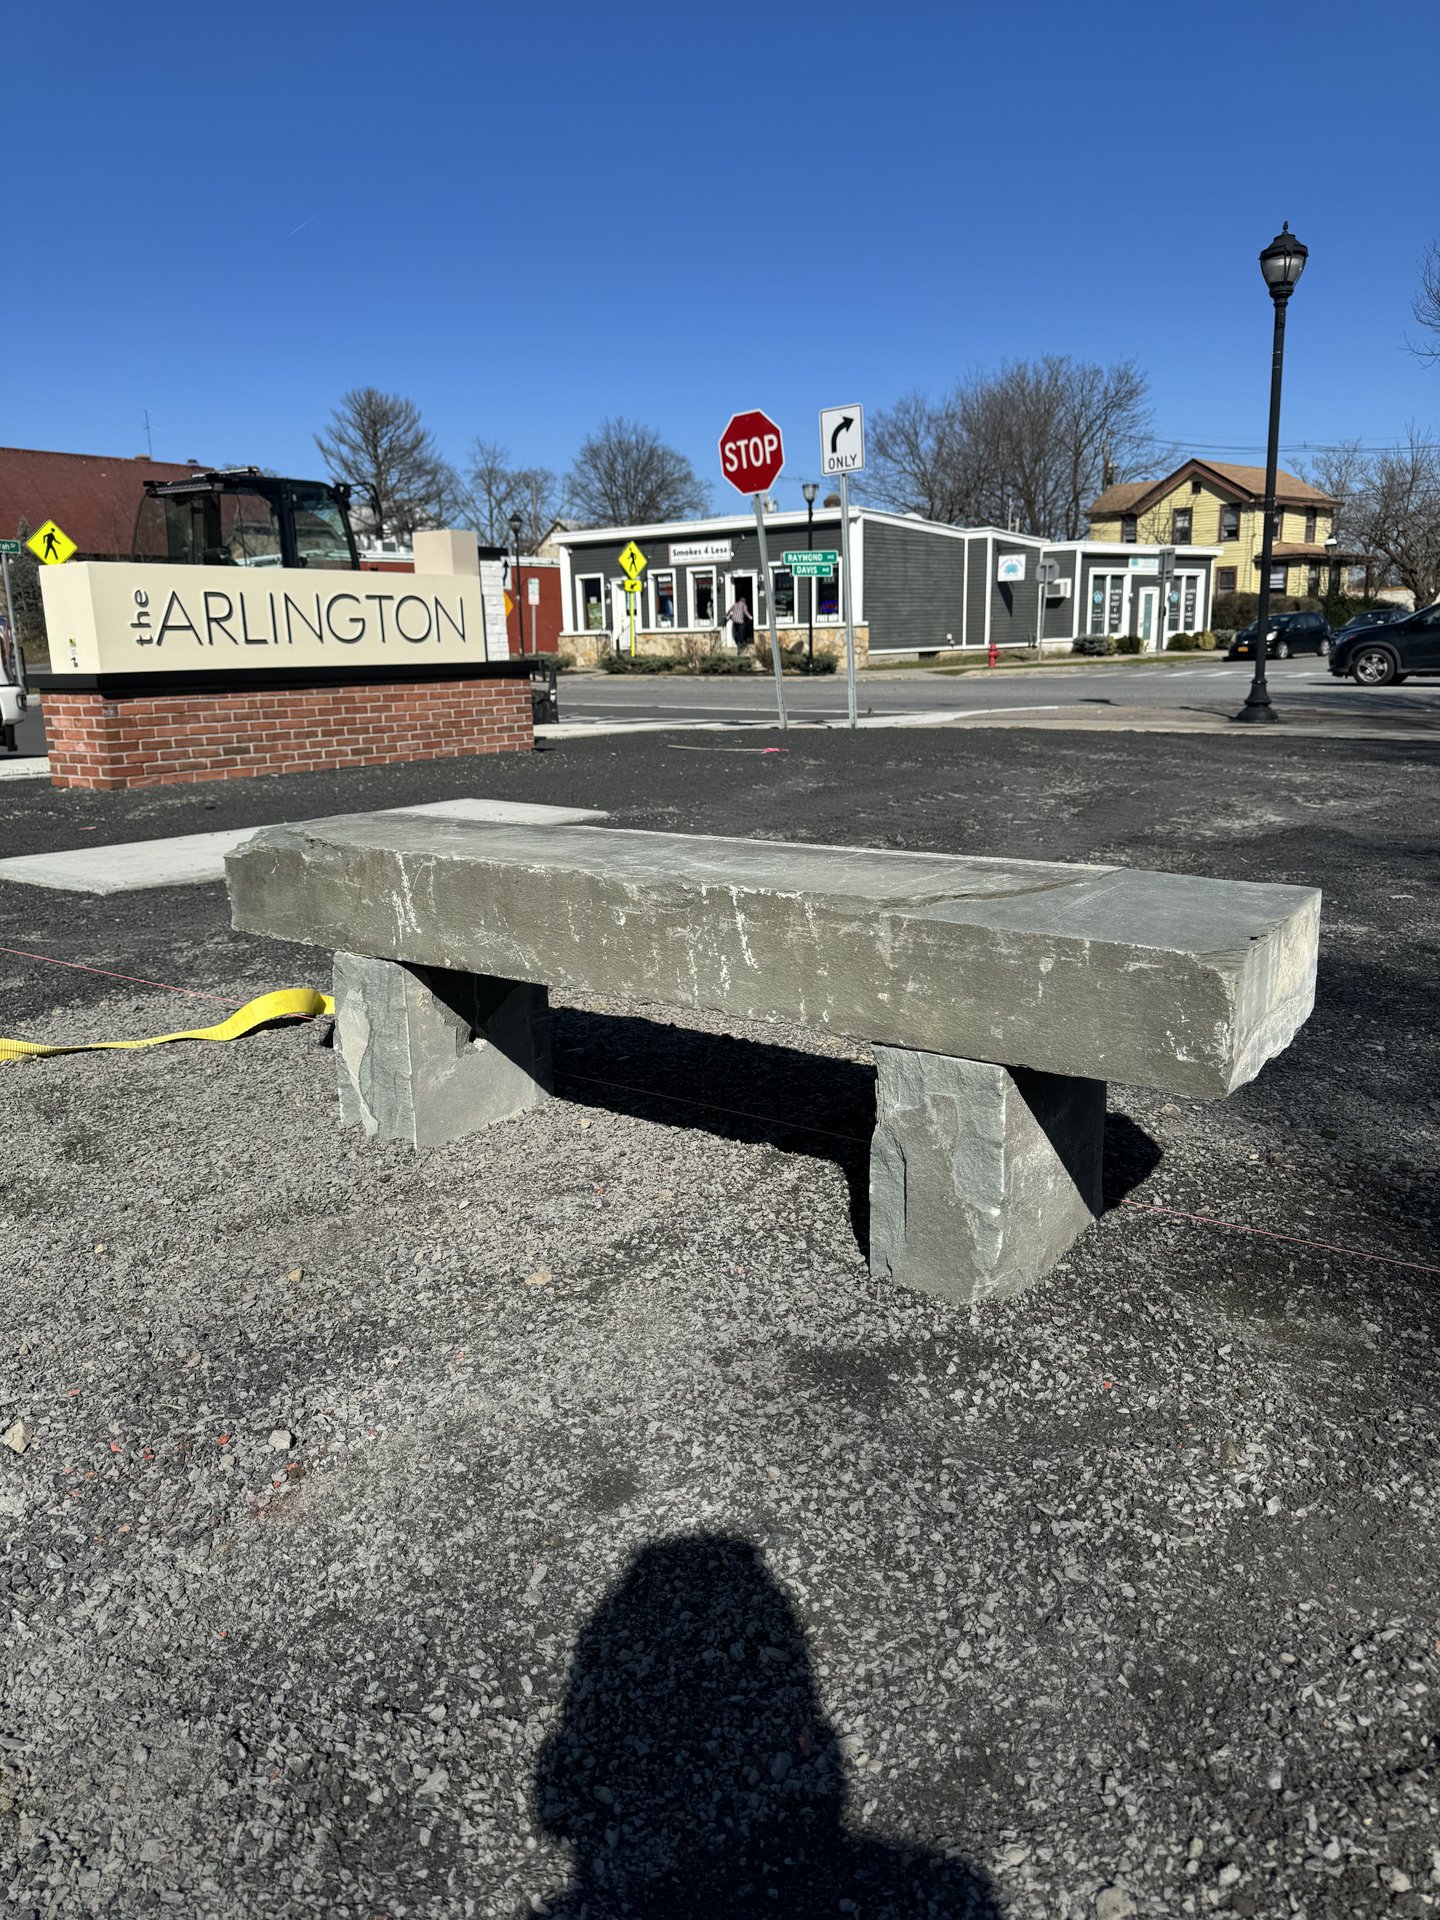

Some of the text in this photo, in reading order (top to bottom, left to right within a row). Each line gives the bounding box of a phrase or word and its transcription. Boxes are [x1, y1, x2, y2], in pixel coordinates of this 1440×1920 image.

[724, 434, 779, 473] STOP
[828, 454, 857, 470] ONLY
[673, 547, 702, 557] Smokes
[711, 546, 727, 554] Less
[787, 553, 823, 562] RAYMOND
[796, 566, 818, 574] DAVIS
[130, 588, 153, 647] the
[156, 589, 466, 647] ARLINGTON
